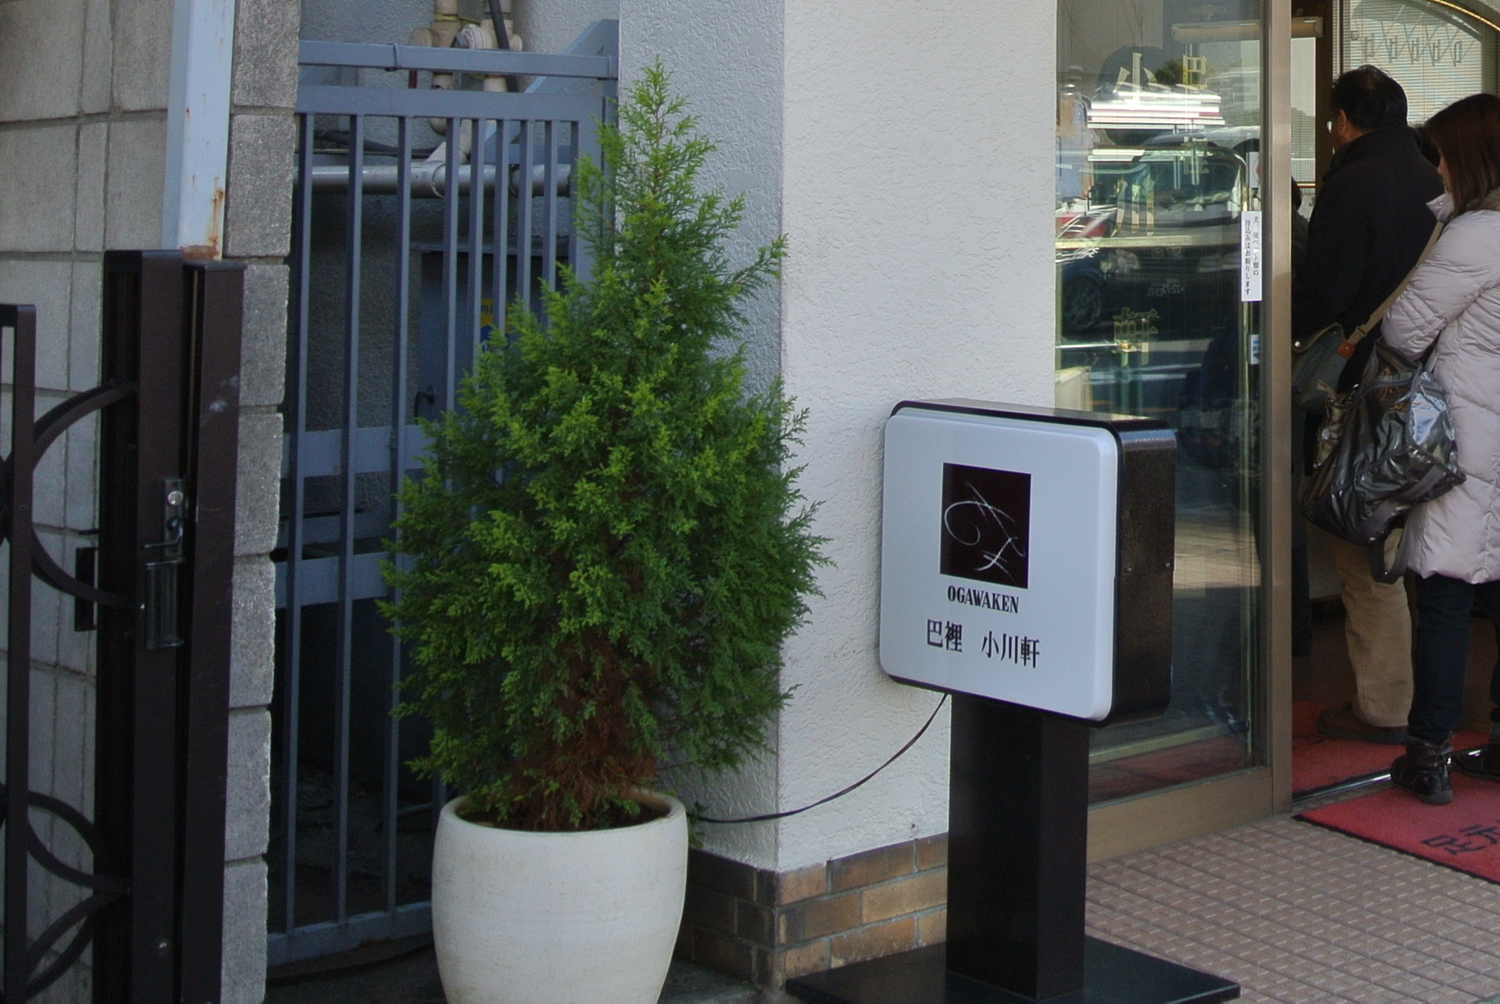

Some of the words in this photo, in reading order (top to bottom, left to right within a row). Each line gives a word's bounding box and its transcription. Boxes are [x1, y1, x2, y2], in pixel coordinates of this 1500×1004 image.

[947, 585, 1020, 614] OGAWAKEN
[927, 618, 963, 653] 巴裡
[981, 630, 1041, 669] 小川軒
